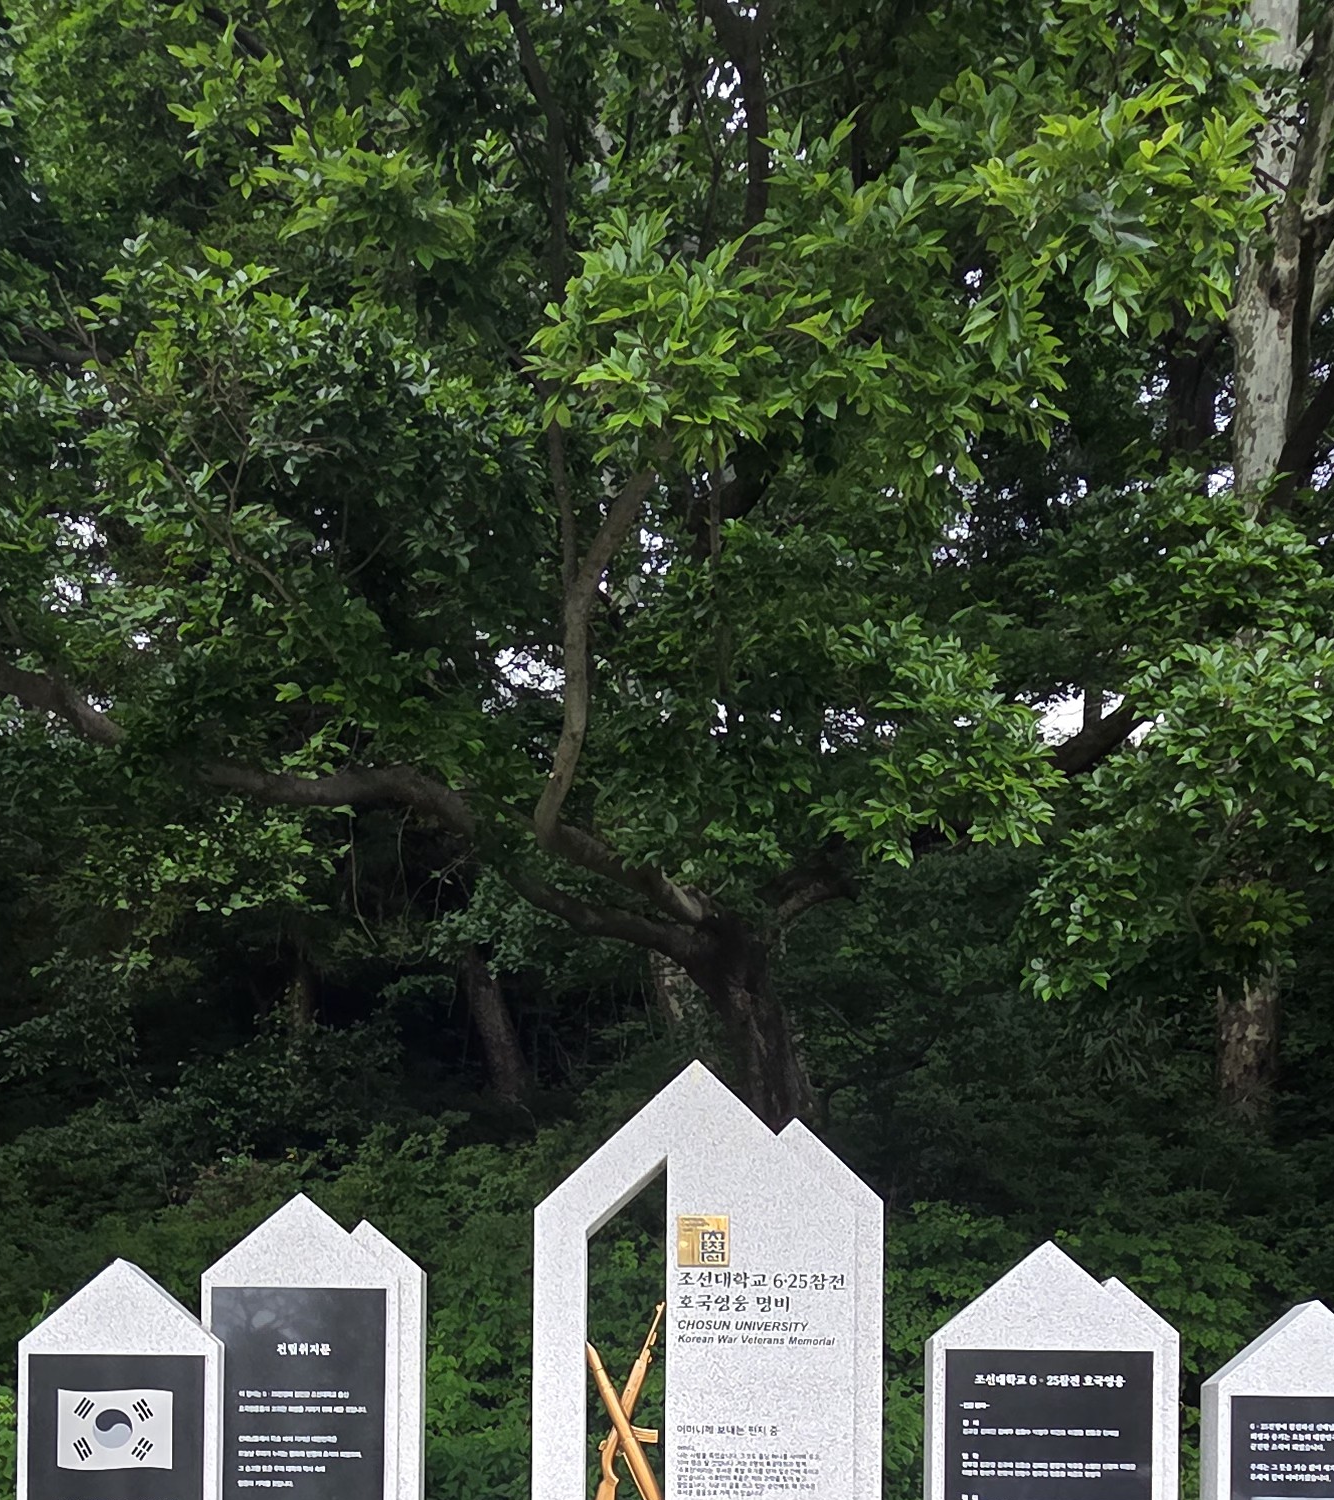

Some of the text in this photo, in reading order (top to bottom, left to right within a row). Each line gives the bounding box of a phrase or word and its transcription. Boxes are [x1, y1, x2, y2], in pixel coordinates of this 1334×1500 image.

[677, 1271, 846, 1291] 조선대학교 6·25참전
[677, 1294, 791, 1313] 호국영웅 명비
[677, 1319, 810, 1333] CHOSUN UNIVERSITY
[677, 1334, 836, 1346] Korean War Veterans Memorial
